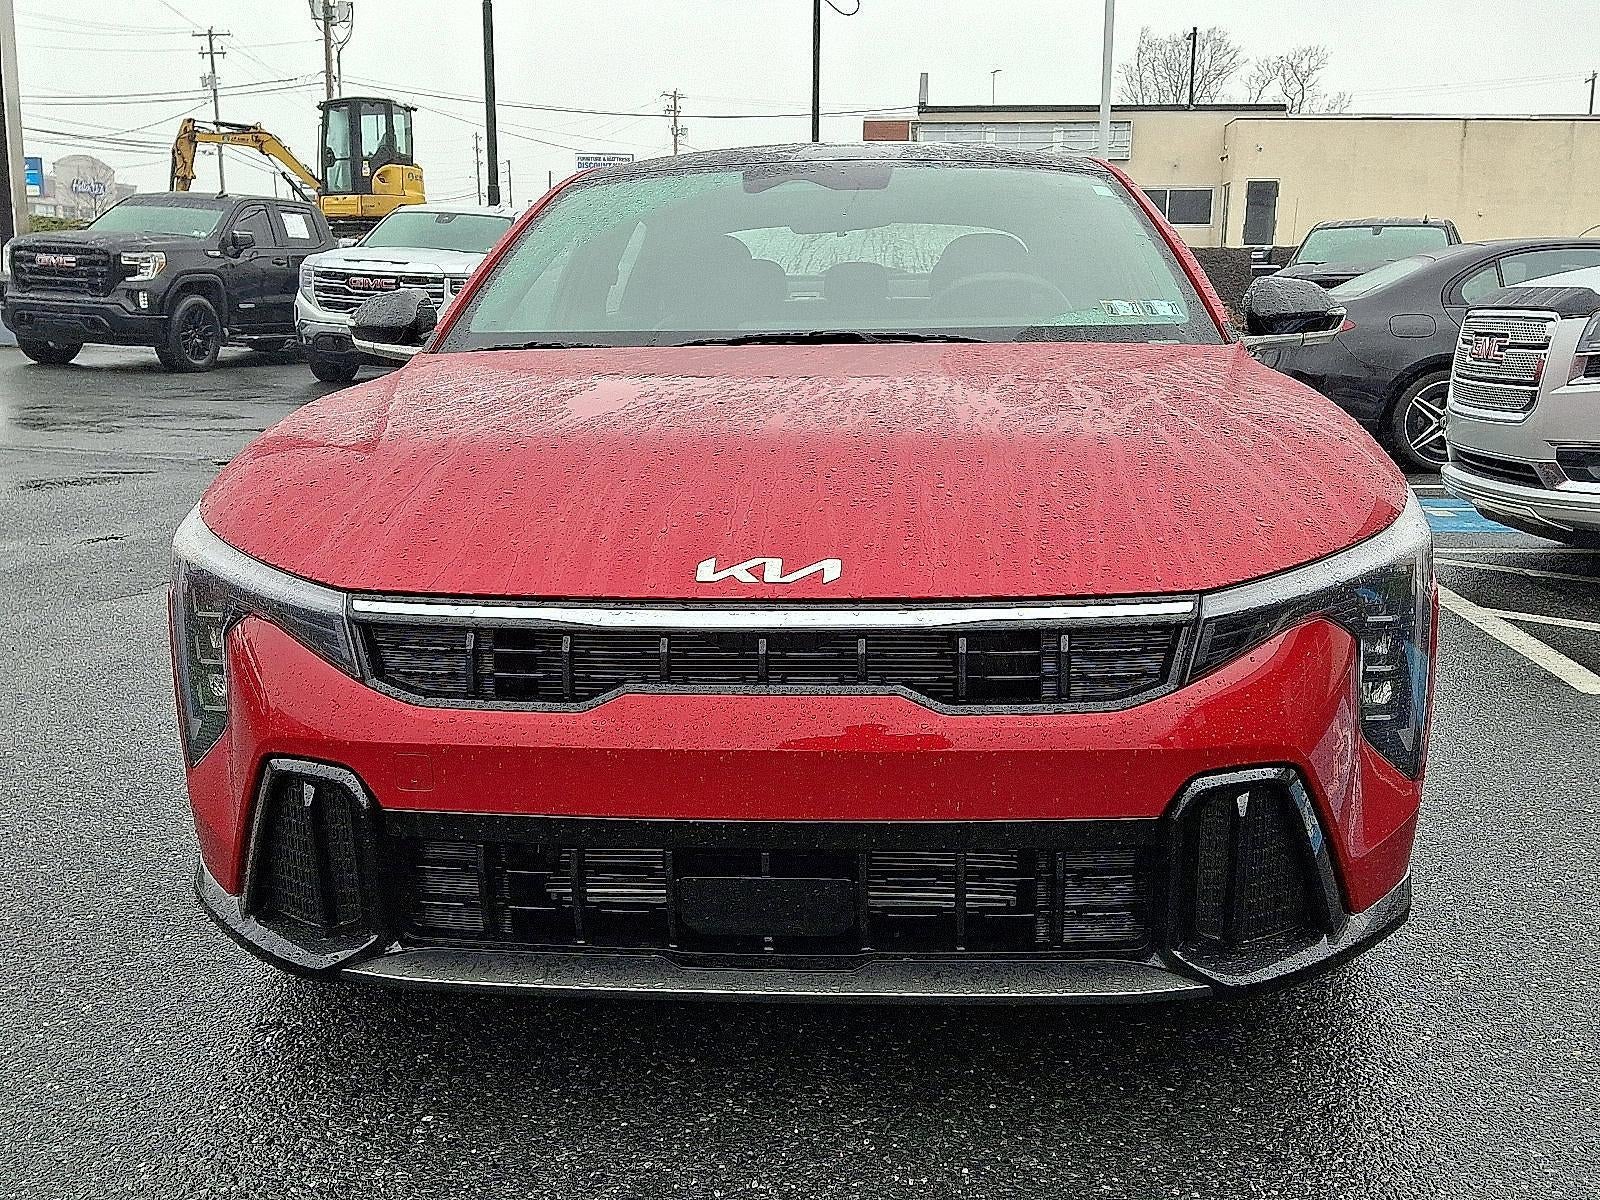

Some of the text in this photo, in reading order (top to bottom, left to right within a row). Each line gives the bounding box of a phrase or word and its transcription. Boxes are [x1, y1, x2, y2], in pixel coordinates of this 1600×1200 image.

[35, 253, 77, 268] GMC
[349, 276, 397, 290] GMC
[1471, 335, 1510, 361] GMC
[695, 557, 842, 585] KIA
